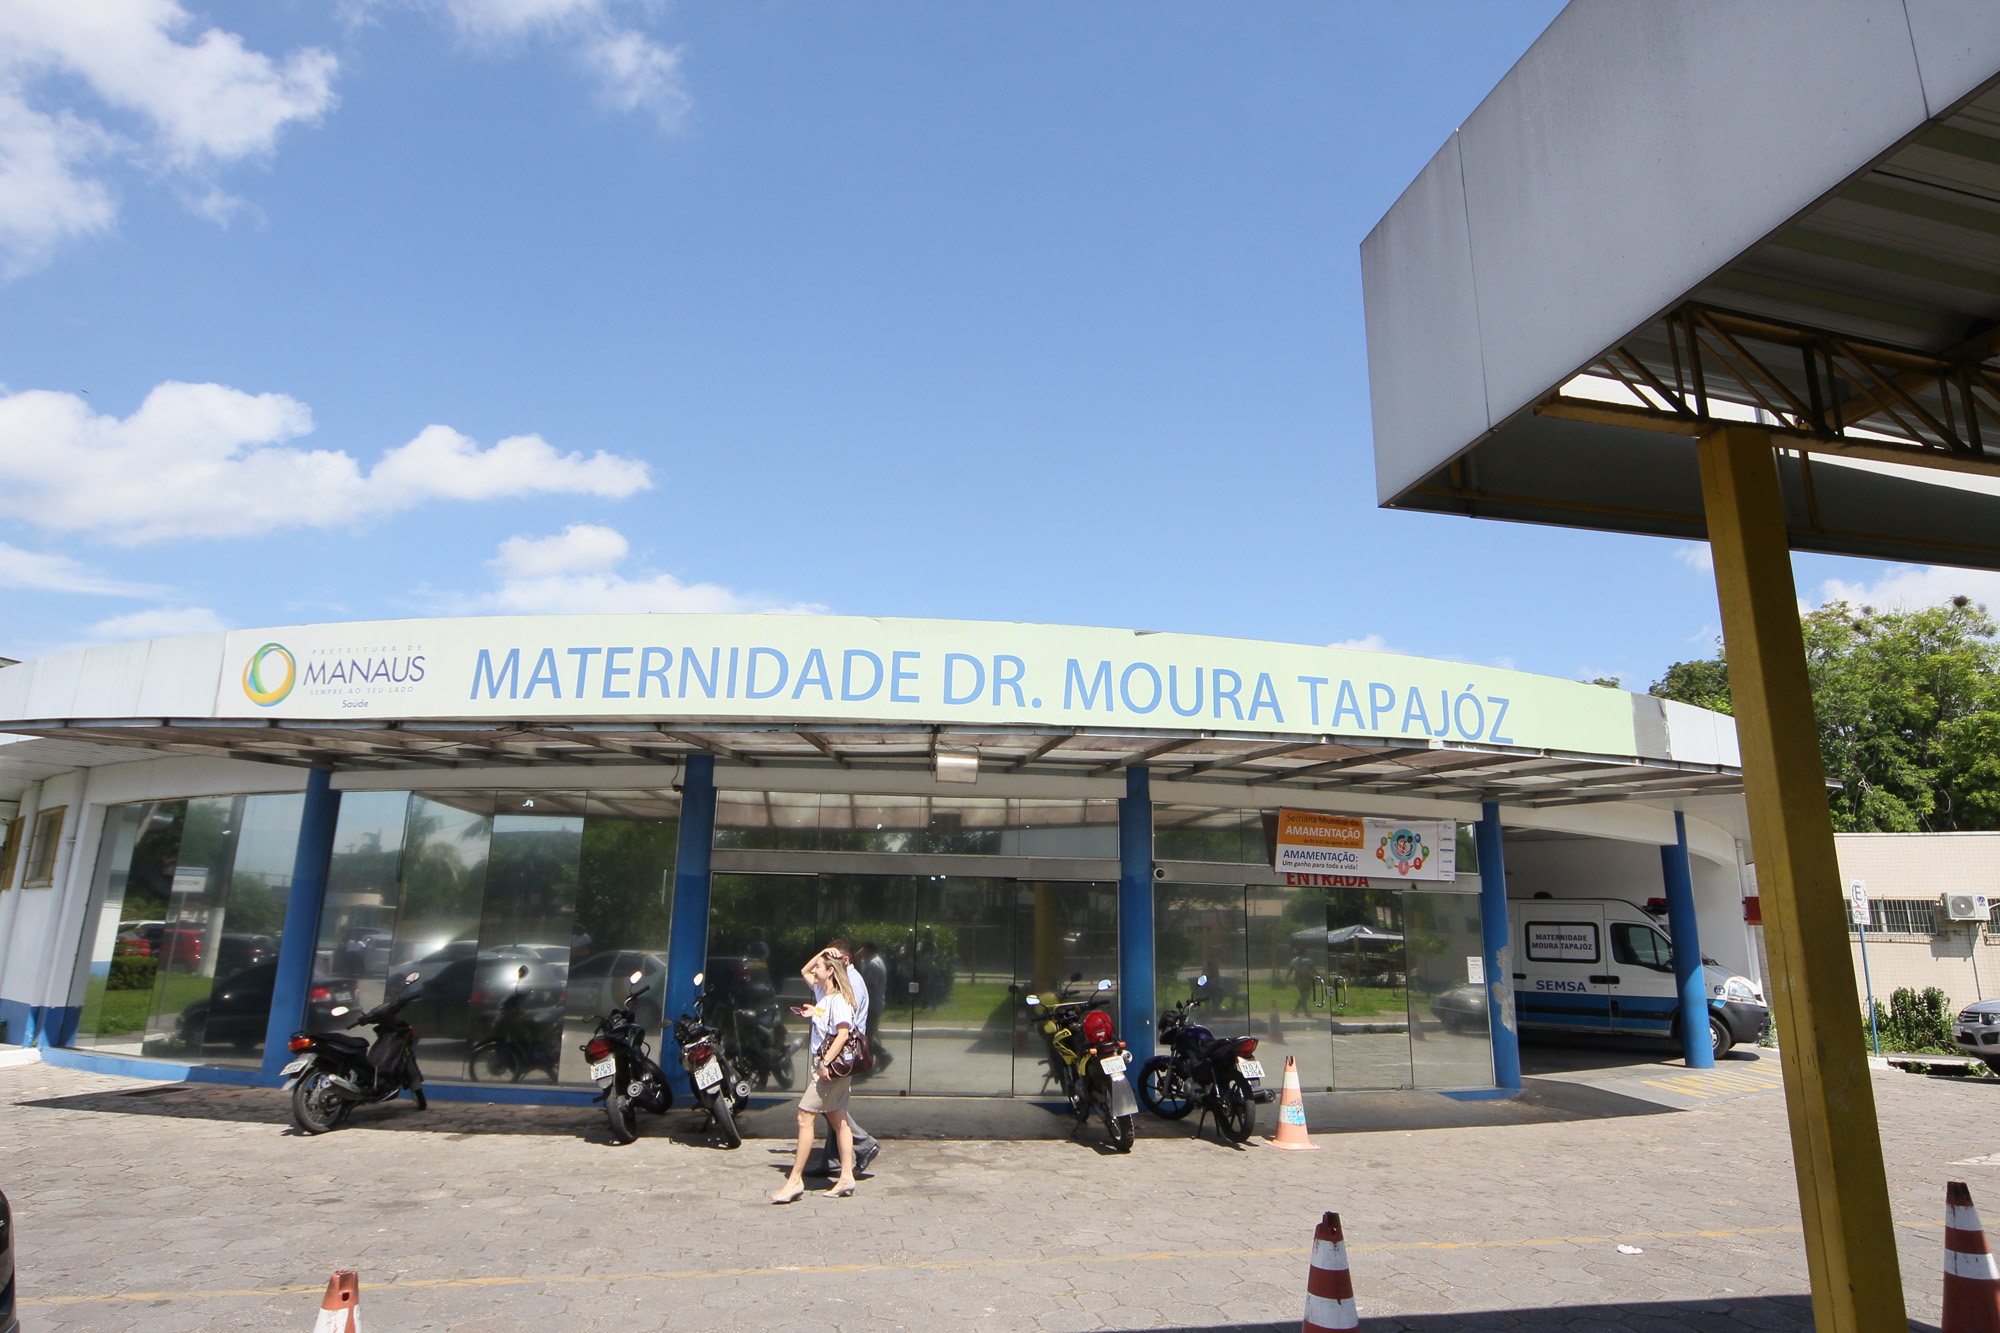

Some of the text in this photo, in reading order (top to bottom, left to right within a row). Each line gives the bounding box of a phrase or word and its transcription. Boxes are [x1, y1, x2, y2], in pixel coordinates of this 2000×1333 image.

[312, 645, 397, 655] PREFEITURA
[303, 655, 426, 686] MANAUS
[310, 688, 343, 696] SEMPRE
[470, 646, 1514, 745] MATERNIDADE DR. MOURA TAPAJÓZ
[342, 698, 369, 709] Saúde
[1286, 813, 1317, 824] Semana
[1318, 816, 1348, 826] Mundial
[1285, 825, 1360, 841] AMAMENTAÇÃO
[1283, 850, 1358, 864] AMAMENTAÇÃO:
[1287, 872, 1370, 888] ENTRADA
[1855, 885, 1862, 901] E
[1536, 980, 1587, 992] SEMSA
